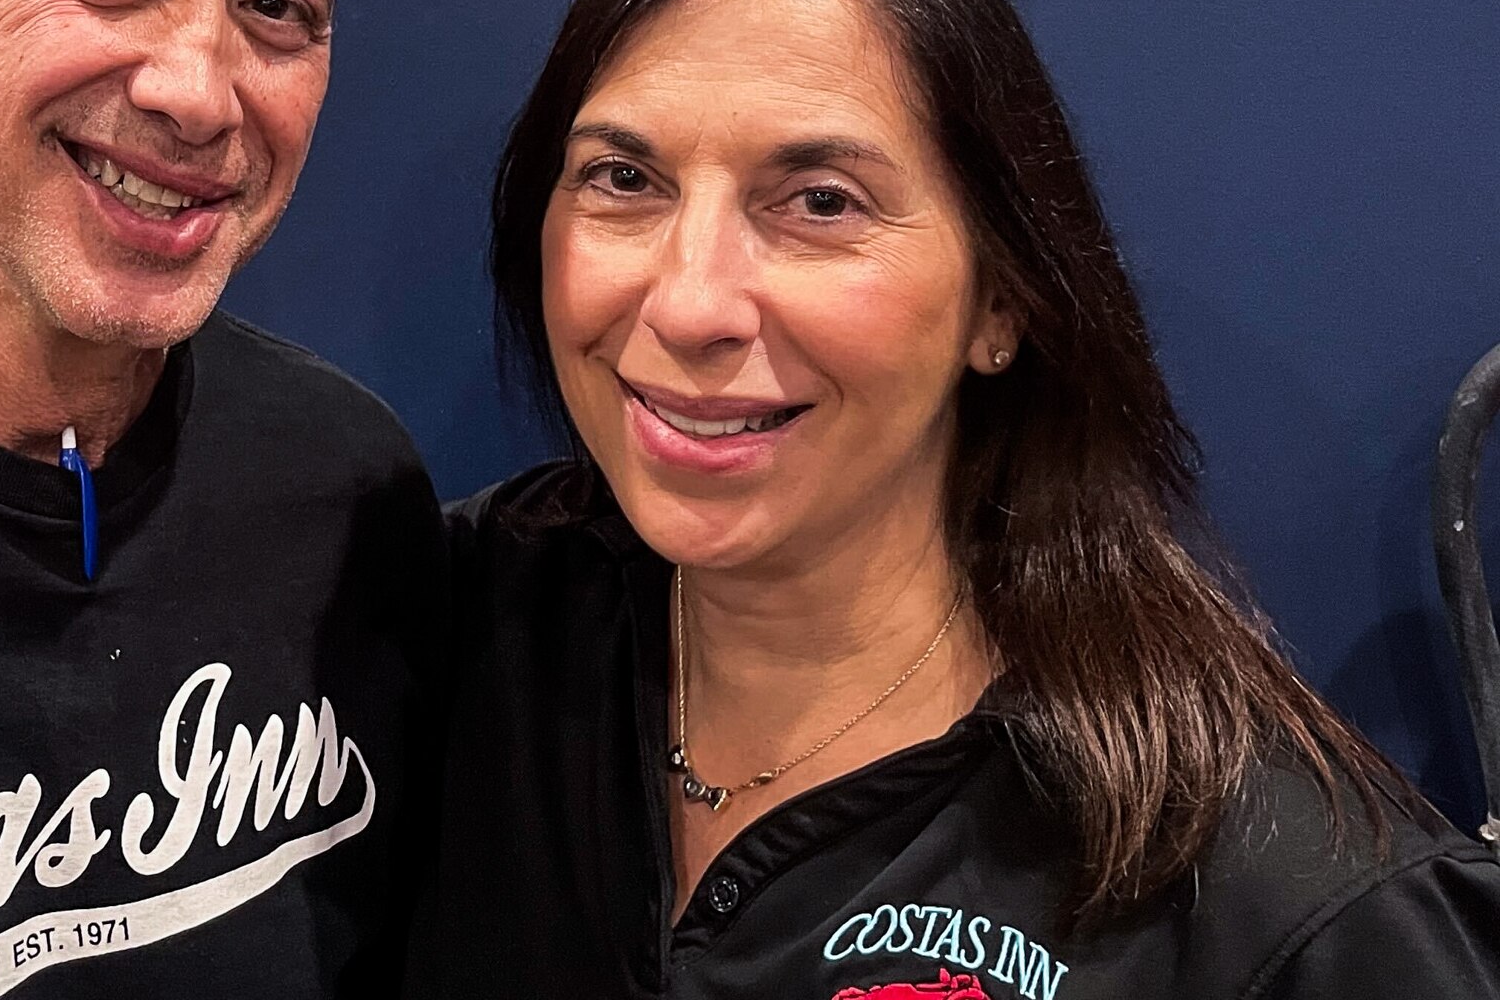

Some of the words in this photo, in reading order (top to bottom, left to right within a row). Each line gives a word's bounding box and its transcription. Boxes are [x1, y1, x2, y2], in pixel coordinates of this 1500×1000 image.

[121, 662, 370, 876] Inn
[12, 927, 64, 968] EST.
[72, 916, 130, 948] 1971
[823, 903, 991, 969] COSTAS
[988, 925, 1069, 1000] INN
